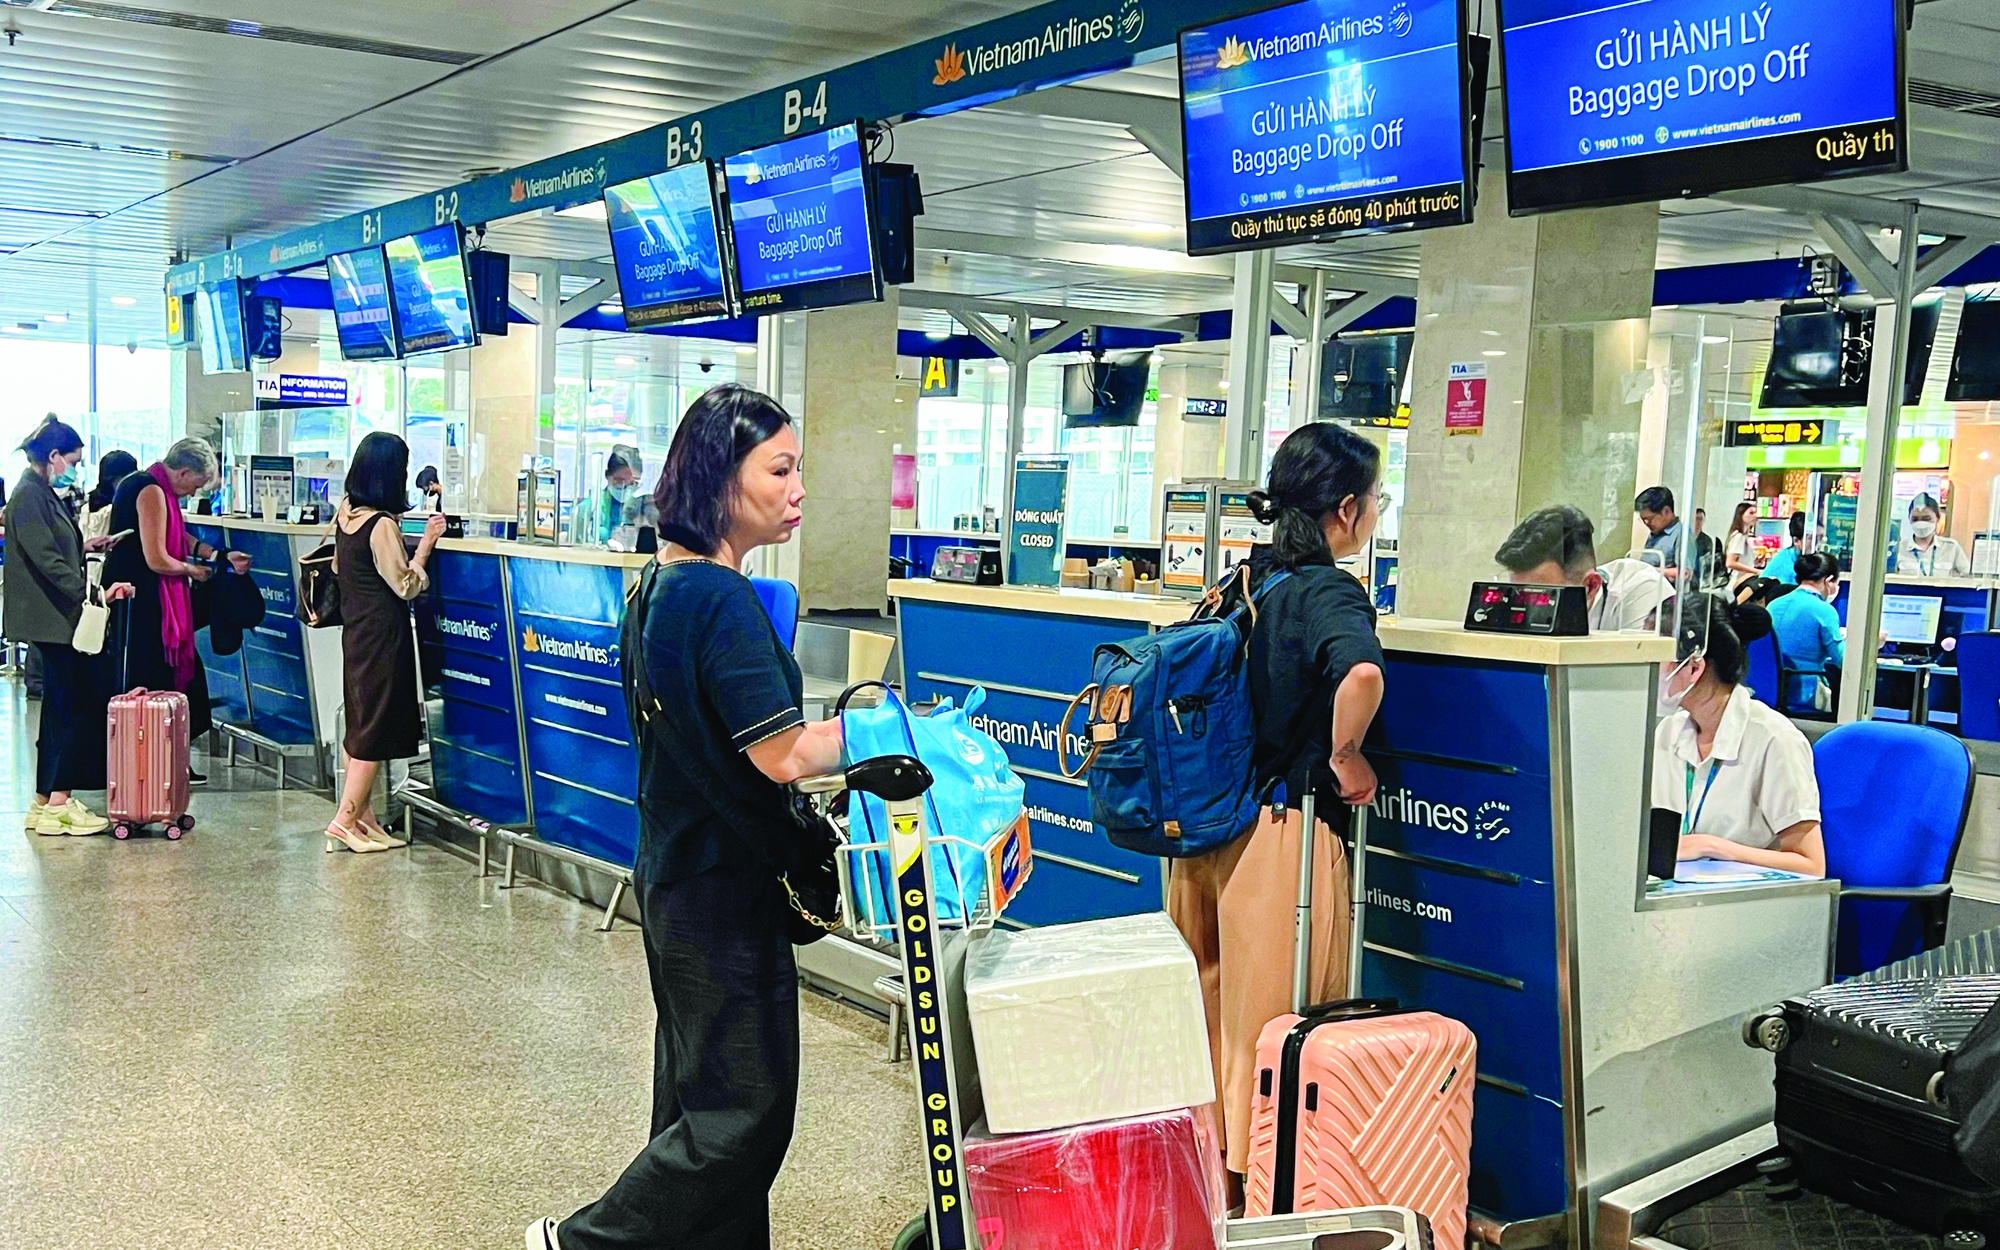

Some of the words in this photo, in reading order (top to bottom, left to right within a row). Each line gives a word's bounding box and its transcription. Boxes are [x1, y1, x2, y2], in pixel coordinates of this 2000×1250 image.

[1596, 27, 1640, 70] GỬI
[1650, 18, 1731, 61] HÀNH
[1741, 2, 1772, 45] LÝ
[1569, 74, 1679, 118] Baggage
[1687, 60, 1755, 96] Drop
[1764, 43, 1811, 82] Off
[783, 81, 827, 135] B-4
[1252, 102, 1285, 136] GỬI
[1291, 94, 1348, 130] HÀNH
[1354, 85, 1376, 118] LÝ
[666, 121, 702, 167] B-3
[1232, 140, 1311, 176] Baggage
[1317, 129, 1366, 160] Drop
[1371, 118, 1404, 149] Off
[1594, 138, 1618, 150] 1900
[1620, 134, 1644, 147] 1100
[1672, 112, 1801, 139] www.vietnamairlines.com
[1816, 132, 1866, 160] Quầy
[1251, 192, 1268, 203] 1900
[1270, 190, 1287, 202] 1100
[1307, 175, 1398, 196] www.vietnamairlines.com
[435, 191, 459, 226] B-2
[1232, 219, 1261, 239] Quầy
[1264, 214, 1285, 233] thủ
[1287, 214, 1307, 234] tục
[1309, 210, 1326, 227] sẽ
[1329, 207, 1361, 228] đóng
[1364, 202, 1382, 220] 40
[1386, 197, 1416, 222] phút
[1420, 191, 1460, 213] trước
[363, 212, 382, 244] B-1
[759, 239, 799, 263] Baggage
[800, 232, 825, 255] Drop
[827, 228, 842, 248] Off
[635, 260, 667, 282] Baggage
[257, 380, 278, 391] TIA
[281, 378, 346, 390] INFORMATION
[924, 356, 947, 390] A
[1451, 365, 1467, 374] TIA
[1192, 401, 1225, 415] 14:21
[1015, 509, 1039, 523] ĐÓNG
[1020, 534, 1054, 548] CLOSED
[968, 713, 1029, 747] ietnam
[904, 889, 940, 1060] GOLDSUN
[927, 1093, 956, 1212] GROUP
